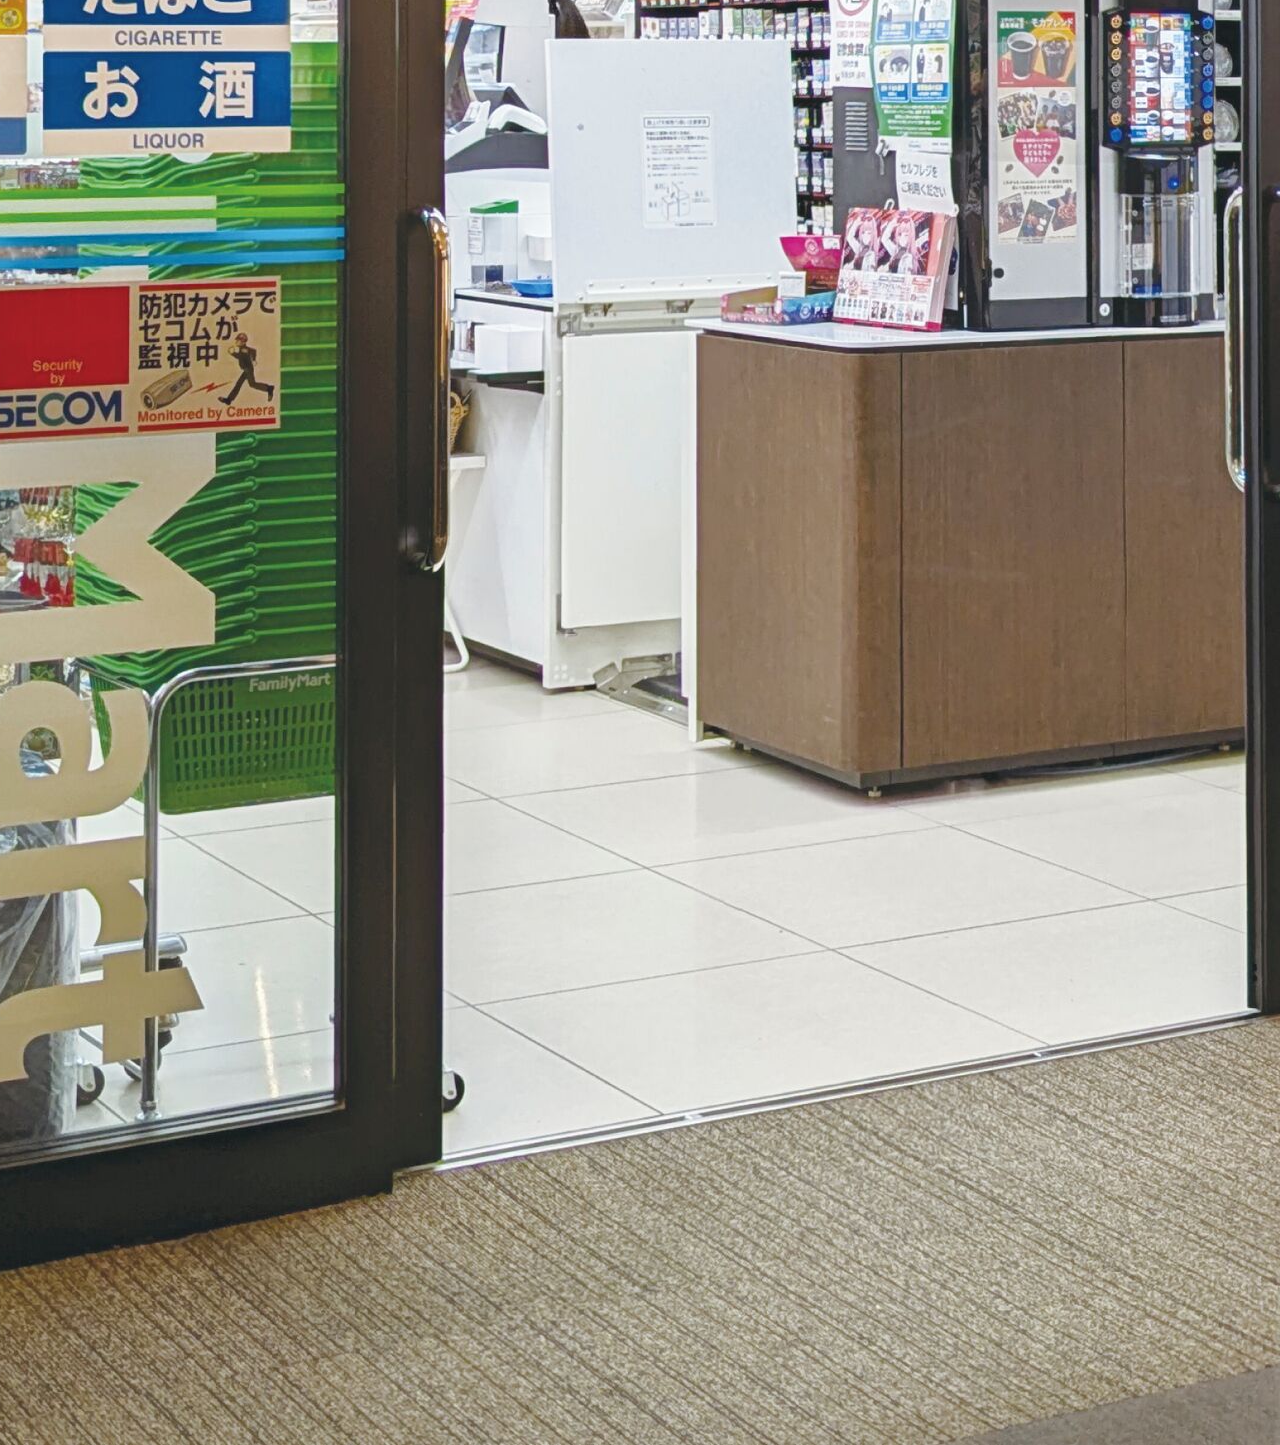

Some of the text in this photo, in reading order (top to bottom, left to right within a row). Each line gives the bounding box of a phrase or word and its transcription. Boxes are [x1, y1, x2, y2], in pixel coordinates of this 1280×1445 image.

[1030, 18, 1073, 29] モカブレンド
[114, 30, 223, 47] CIGARETTE
[81, 60, 257, 120] お酒
[133, 133, 205, 151] LIQUOR
[900, 163, 938, 179] セルフレジを
[901, 181, 947, 198] ご利用ください
[138, 291, 277, 319] 防犯カメラで
[138, 316, 239, 343] セコムが
[137, 342, 219, 370] 監視中
[32, 359, 83, 374] Security
[50, 373, 65, 386] by
[138, 406, 276, 423] Monitored by Camera
[249, 671, 332, 694] FamilyMart
